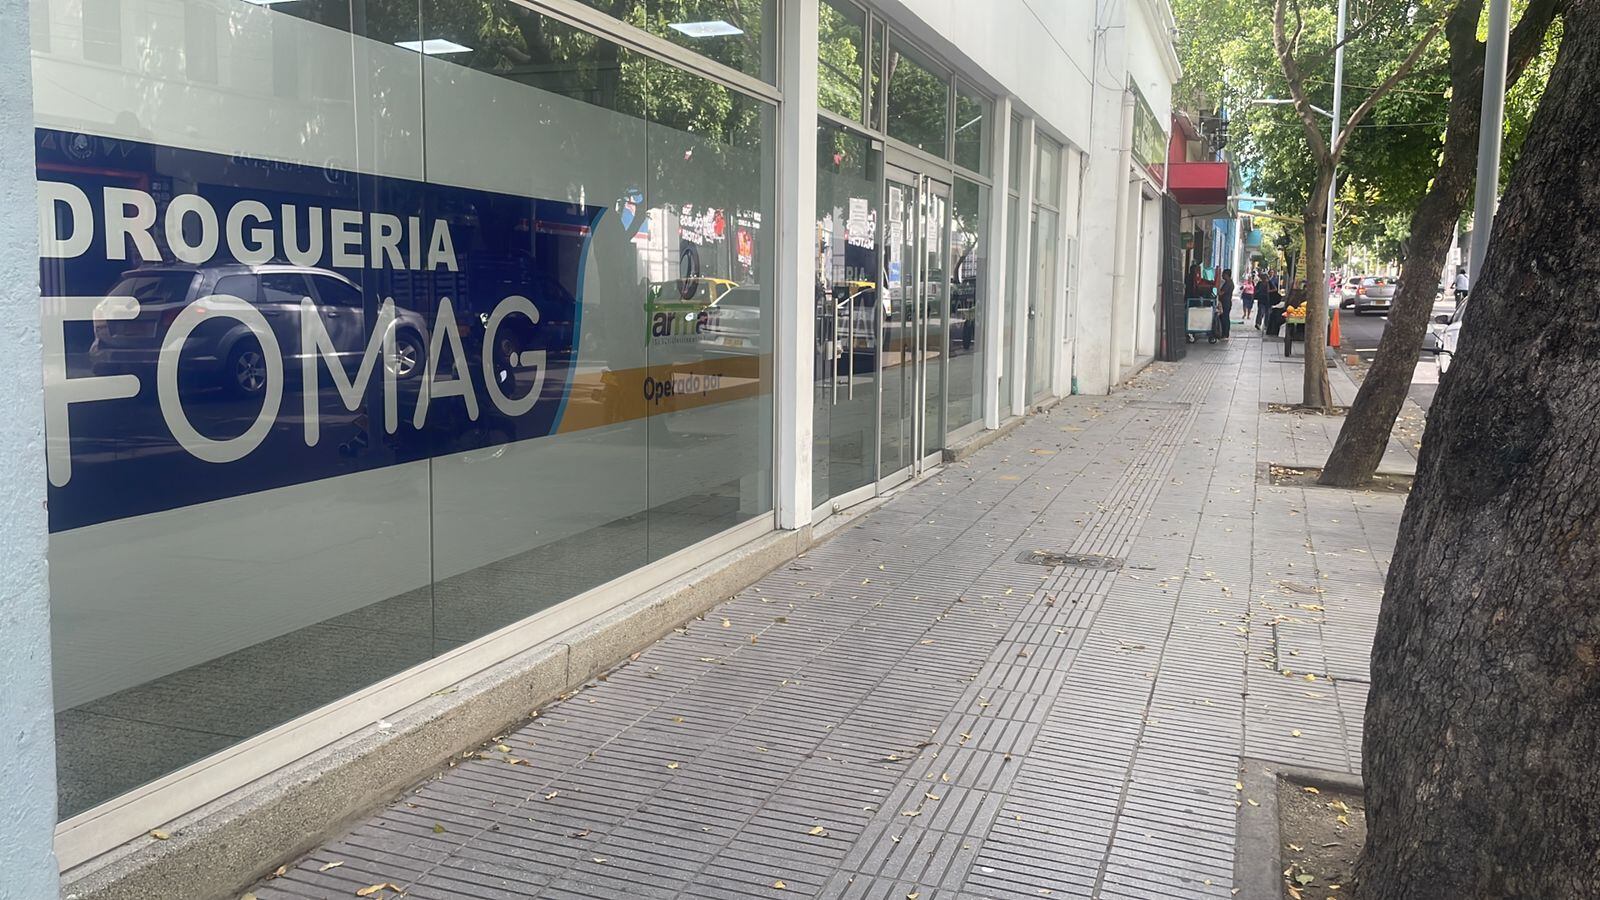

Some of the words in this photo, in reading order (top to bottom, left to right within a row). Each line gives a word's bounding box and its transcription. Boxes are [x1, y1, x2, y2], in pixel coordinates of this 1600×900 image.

[37, 180, 458, 272] DROGUERIA
[41, 294, 547, 488] FOMAG
[643, 372, 700, 405] Operado
[703, 374, 722, 397] por
